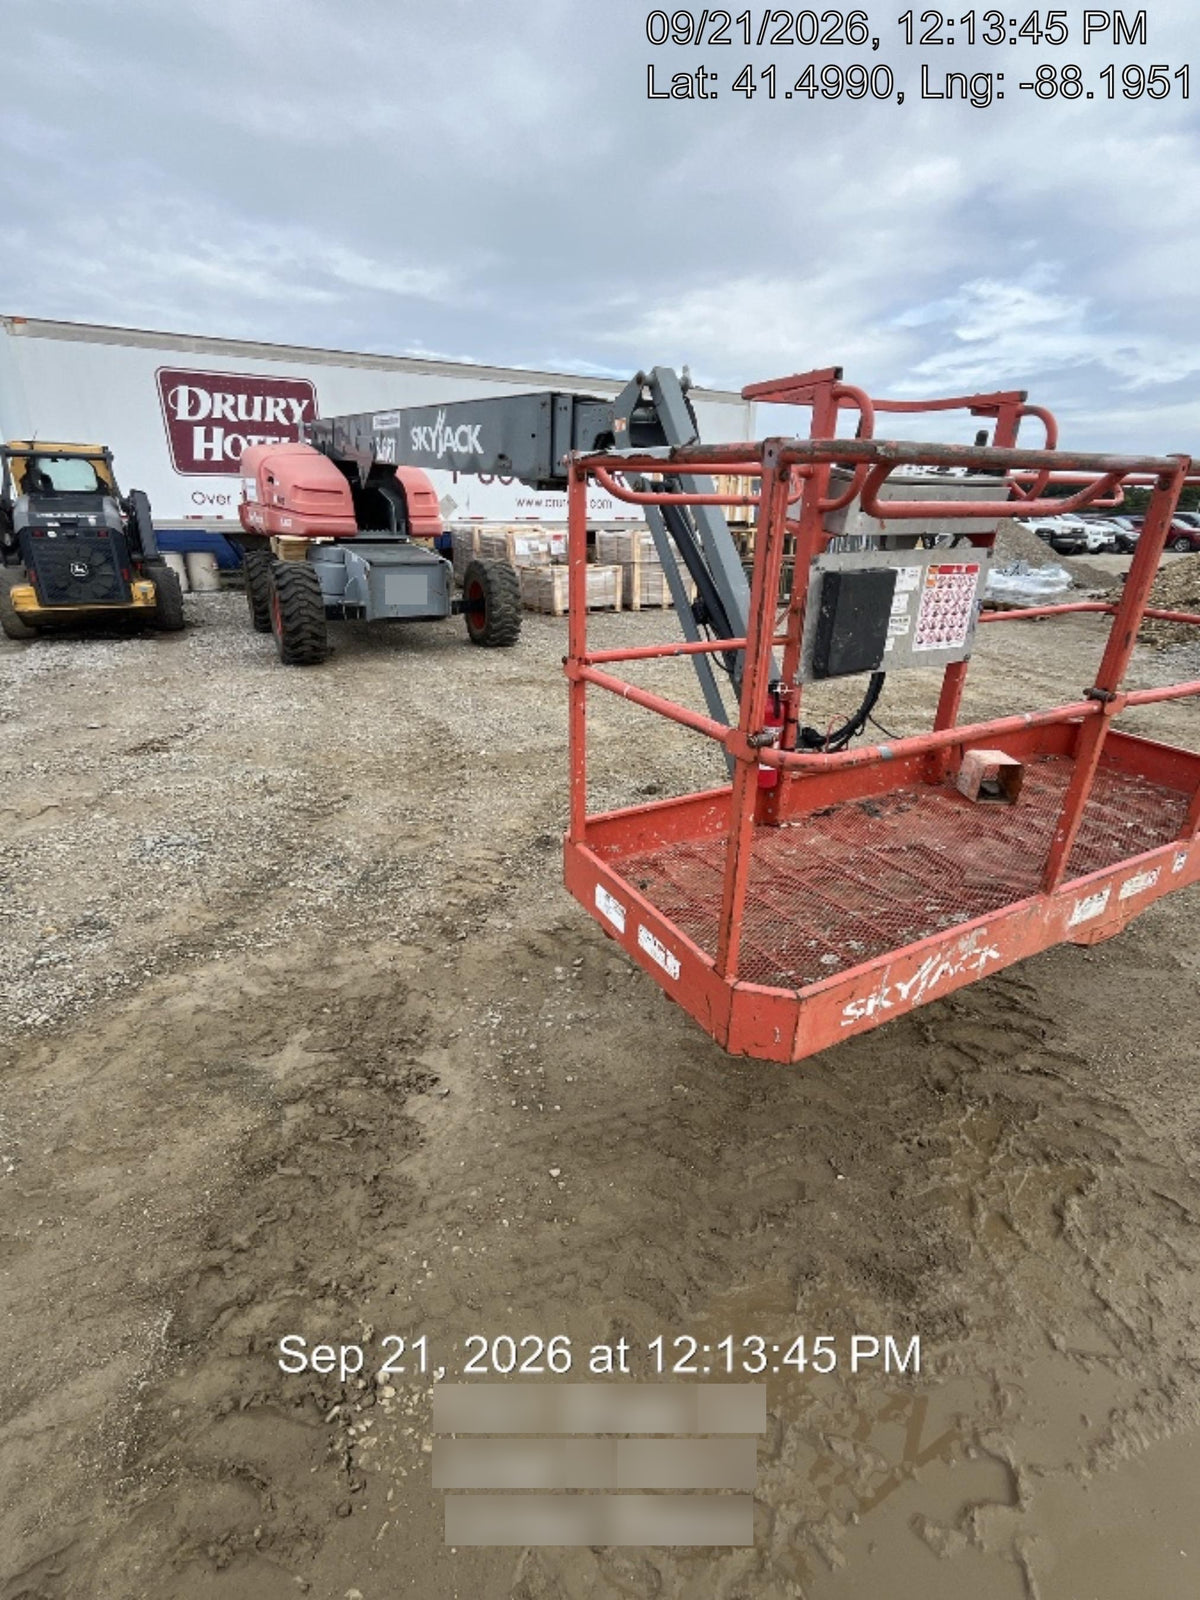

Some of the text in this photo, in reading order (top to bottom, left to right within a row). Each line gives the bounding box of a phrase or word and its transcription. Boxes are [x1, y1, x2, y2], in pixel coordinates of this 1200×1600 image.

[168, 385, 310, 425] DRURY
[410, 408, 484, 459] SKYJACK
[191, 491, 231, 505] Over
